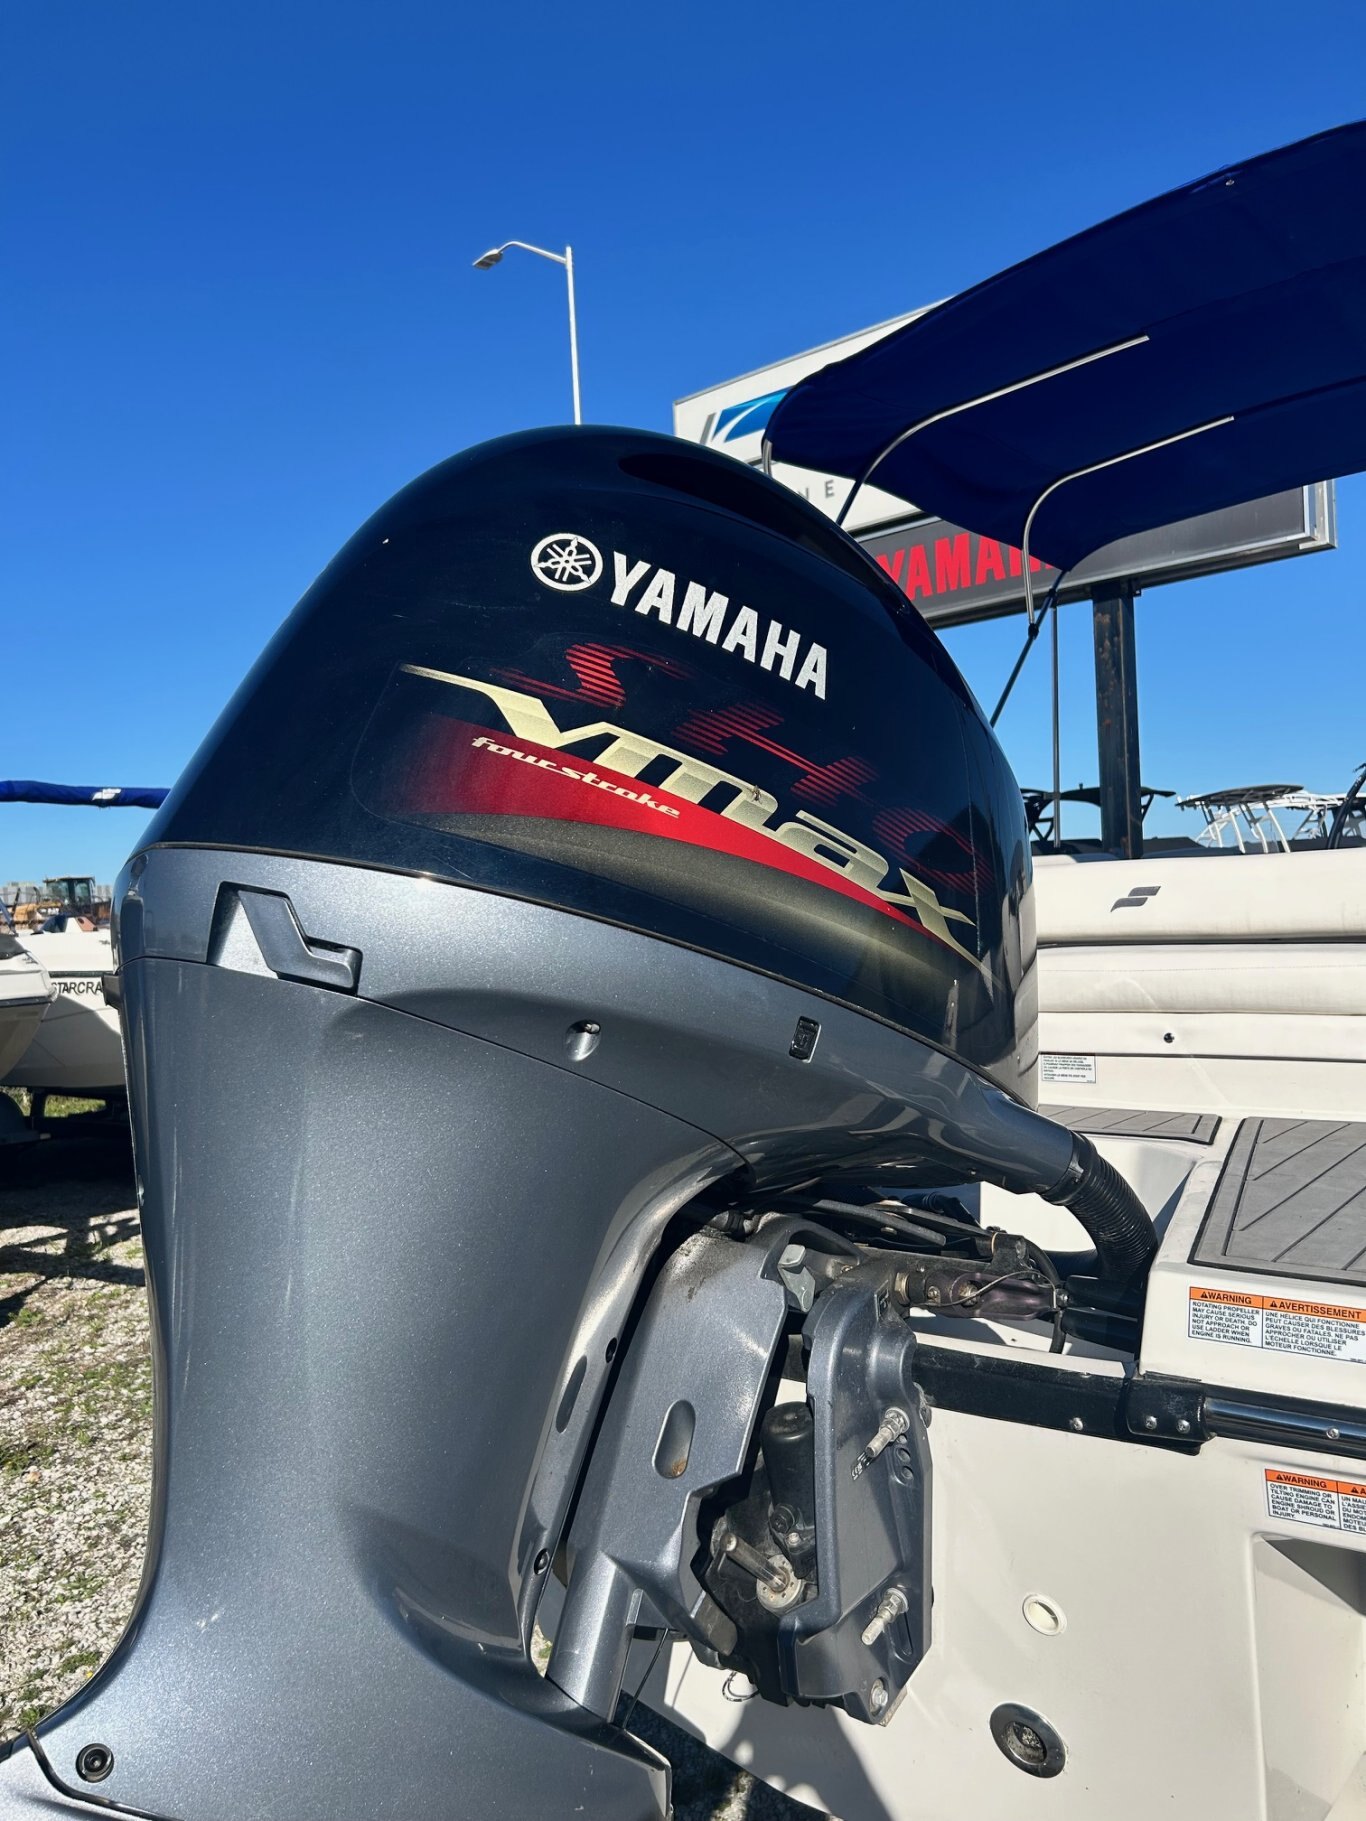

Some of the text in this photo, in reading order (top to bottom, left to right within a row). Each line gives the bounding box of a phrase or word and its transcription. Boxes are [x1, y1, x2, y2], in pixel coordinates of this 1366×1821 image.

[876, 532, 1053, 600] YAMA
[610, 551, 827, 700] YAMAHA
[1208, 1292, 1252, 1304] WARNING
[1192, 1302, 1259, 1314] ROTATING PROPELLER
[1279, 1302, 1361, 1319] AVERTISSEMENT
[1228, 1312, 1254, 1320] SERIOUS
[1206, 1320, 1239, 1329] APPROACH
[1265, 1323, 1290, 1331] GRAVES
[1284, 1320, 1309, 1328] CAUSER
[1326, 1325, 1365, 1336] BLESSURES
[1318, 1319, 1360, 1329] FONCTIONNE
[1265, 1329, 1304, 1339] APPROCHER
[1318, 1337, 1346, 1345] UTILISER
[1265, 1341, 1292, 1349] MOTEUR
[1301, 1339, 1331, 1349] LORSQUE
[1283, 1475, 1326, 1488] WARNING
[1290, 1487, 1320, 1496] TRIMMING
[1294, 1498, 1321, 1507] DAMAGE
[1297, 1504, 1323, 1513] SHROUD
[1302, 1510, 1336, 1521] PERSONAL
